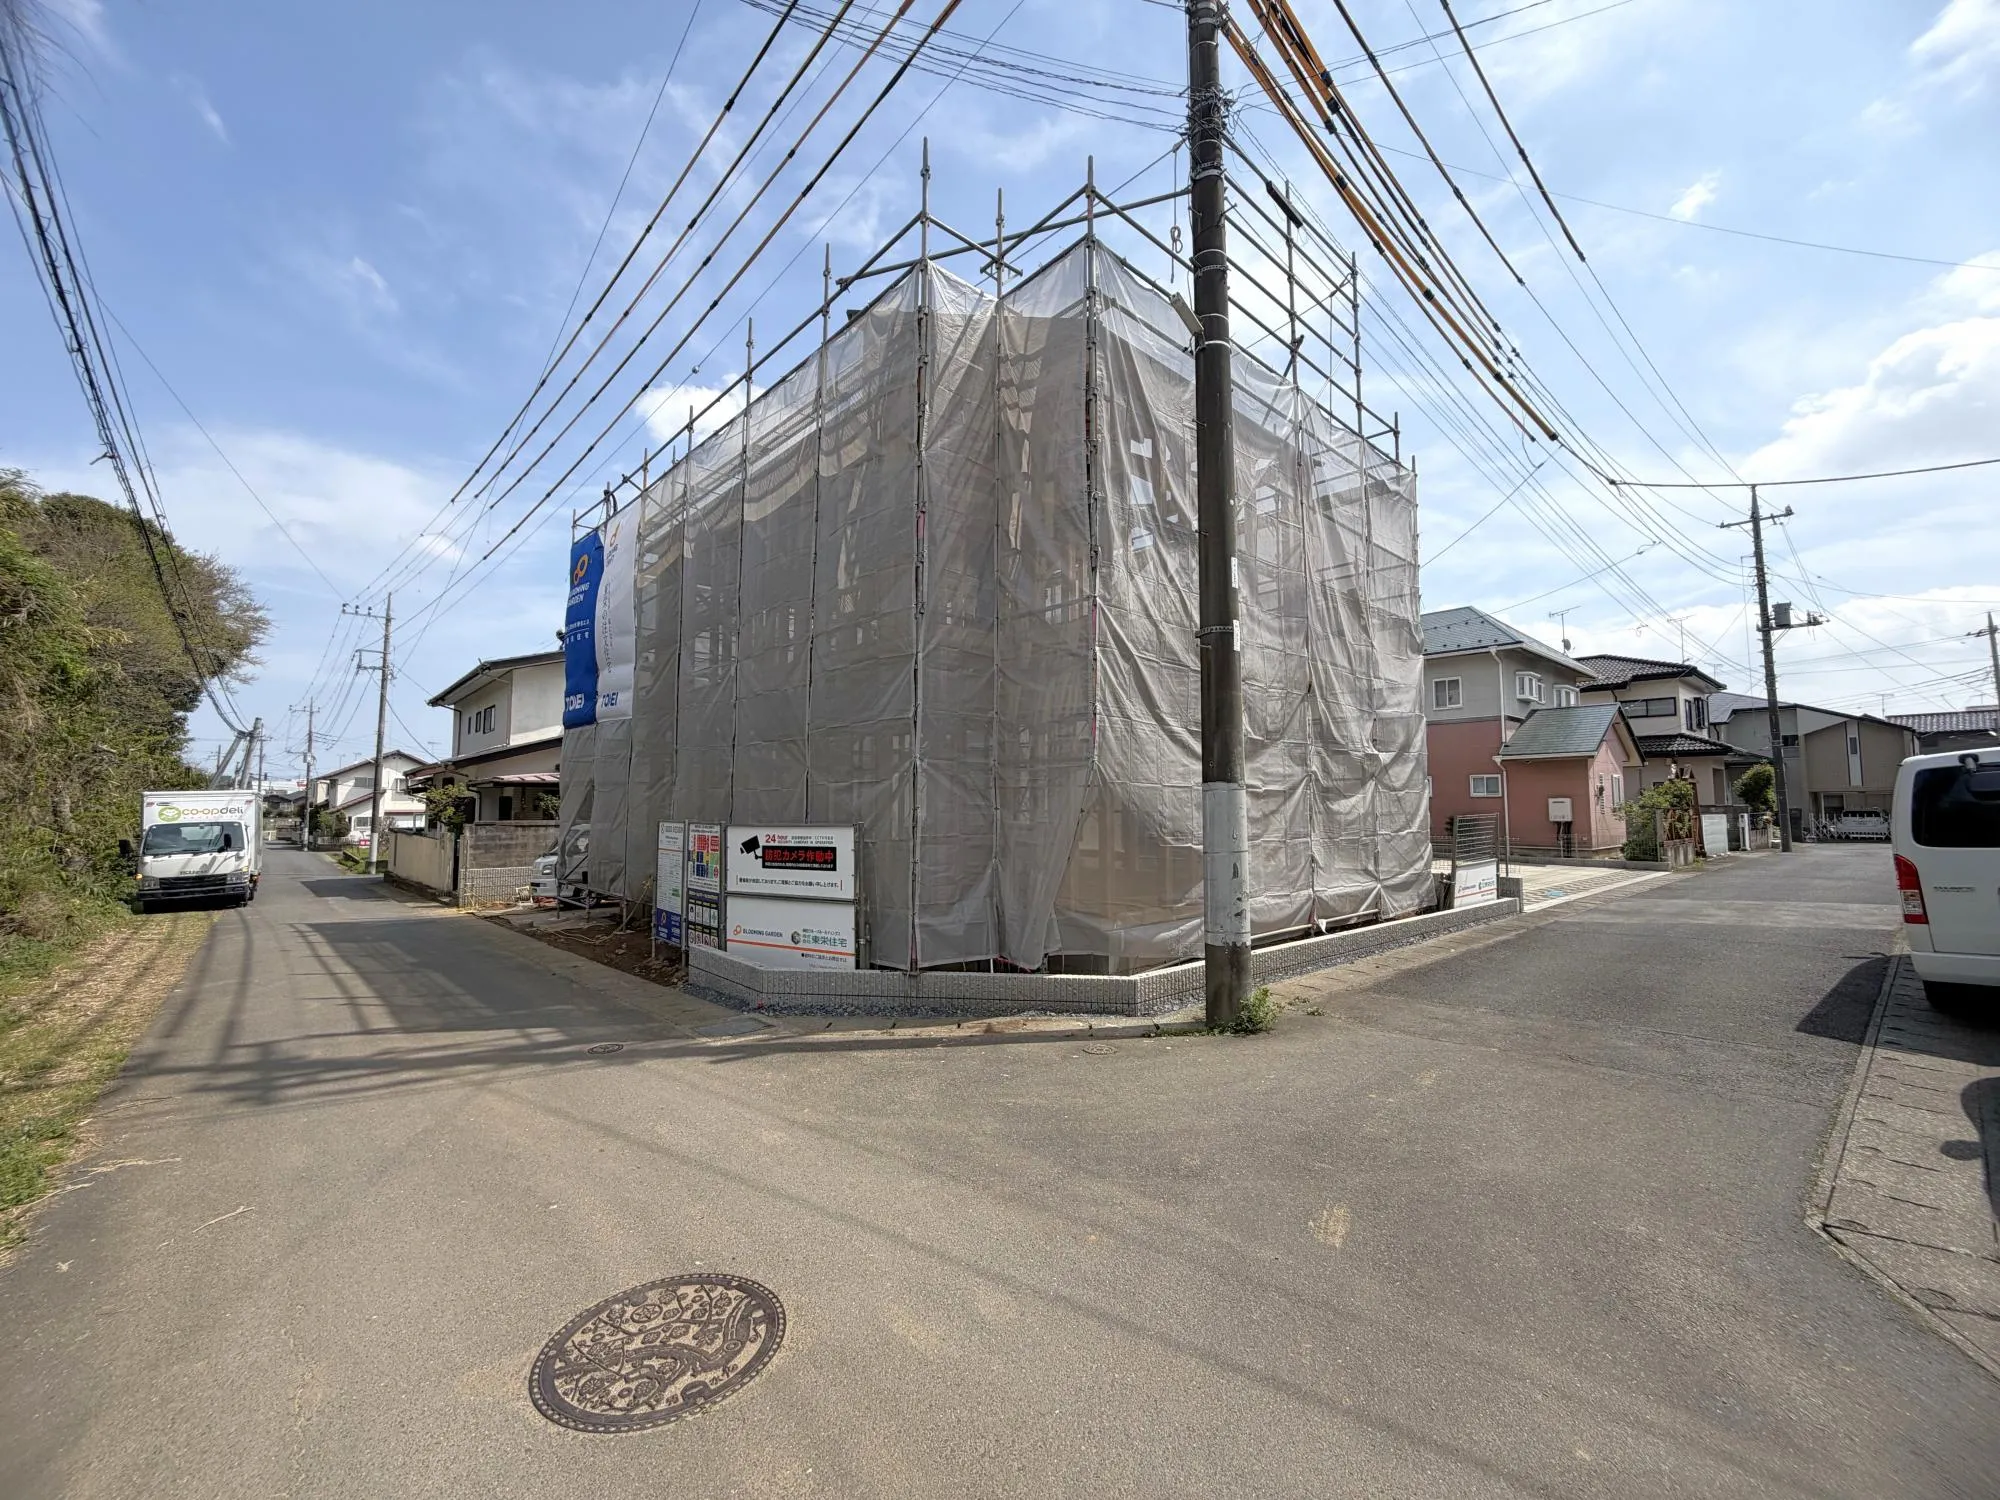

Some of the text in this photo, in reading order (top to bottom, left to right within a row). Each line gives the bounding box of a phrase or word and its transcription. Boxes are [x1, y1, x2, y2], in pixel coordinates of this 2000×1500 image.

[765, 834, 776, 843] 24
[765, 850, 833, 862] 防犯カメラ作動中
[765, 929, 784, 938] GARDEN
[811, 934, 848, 948] 東栄住宅
